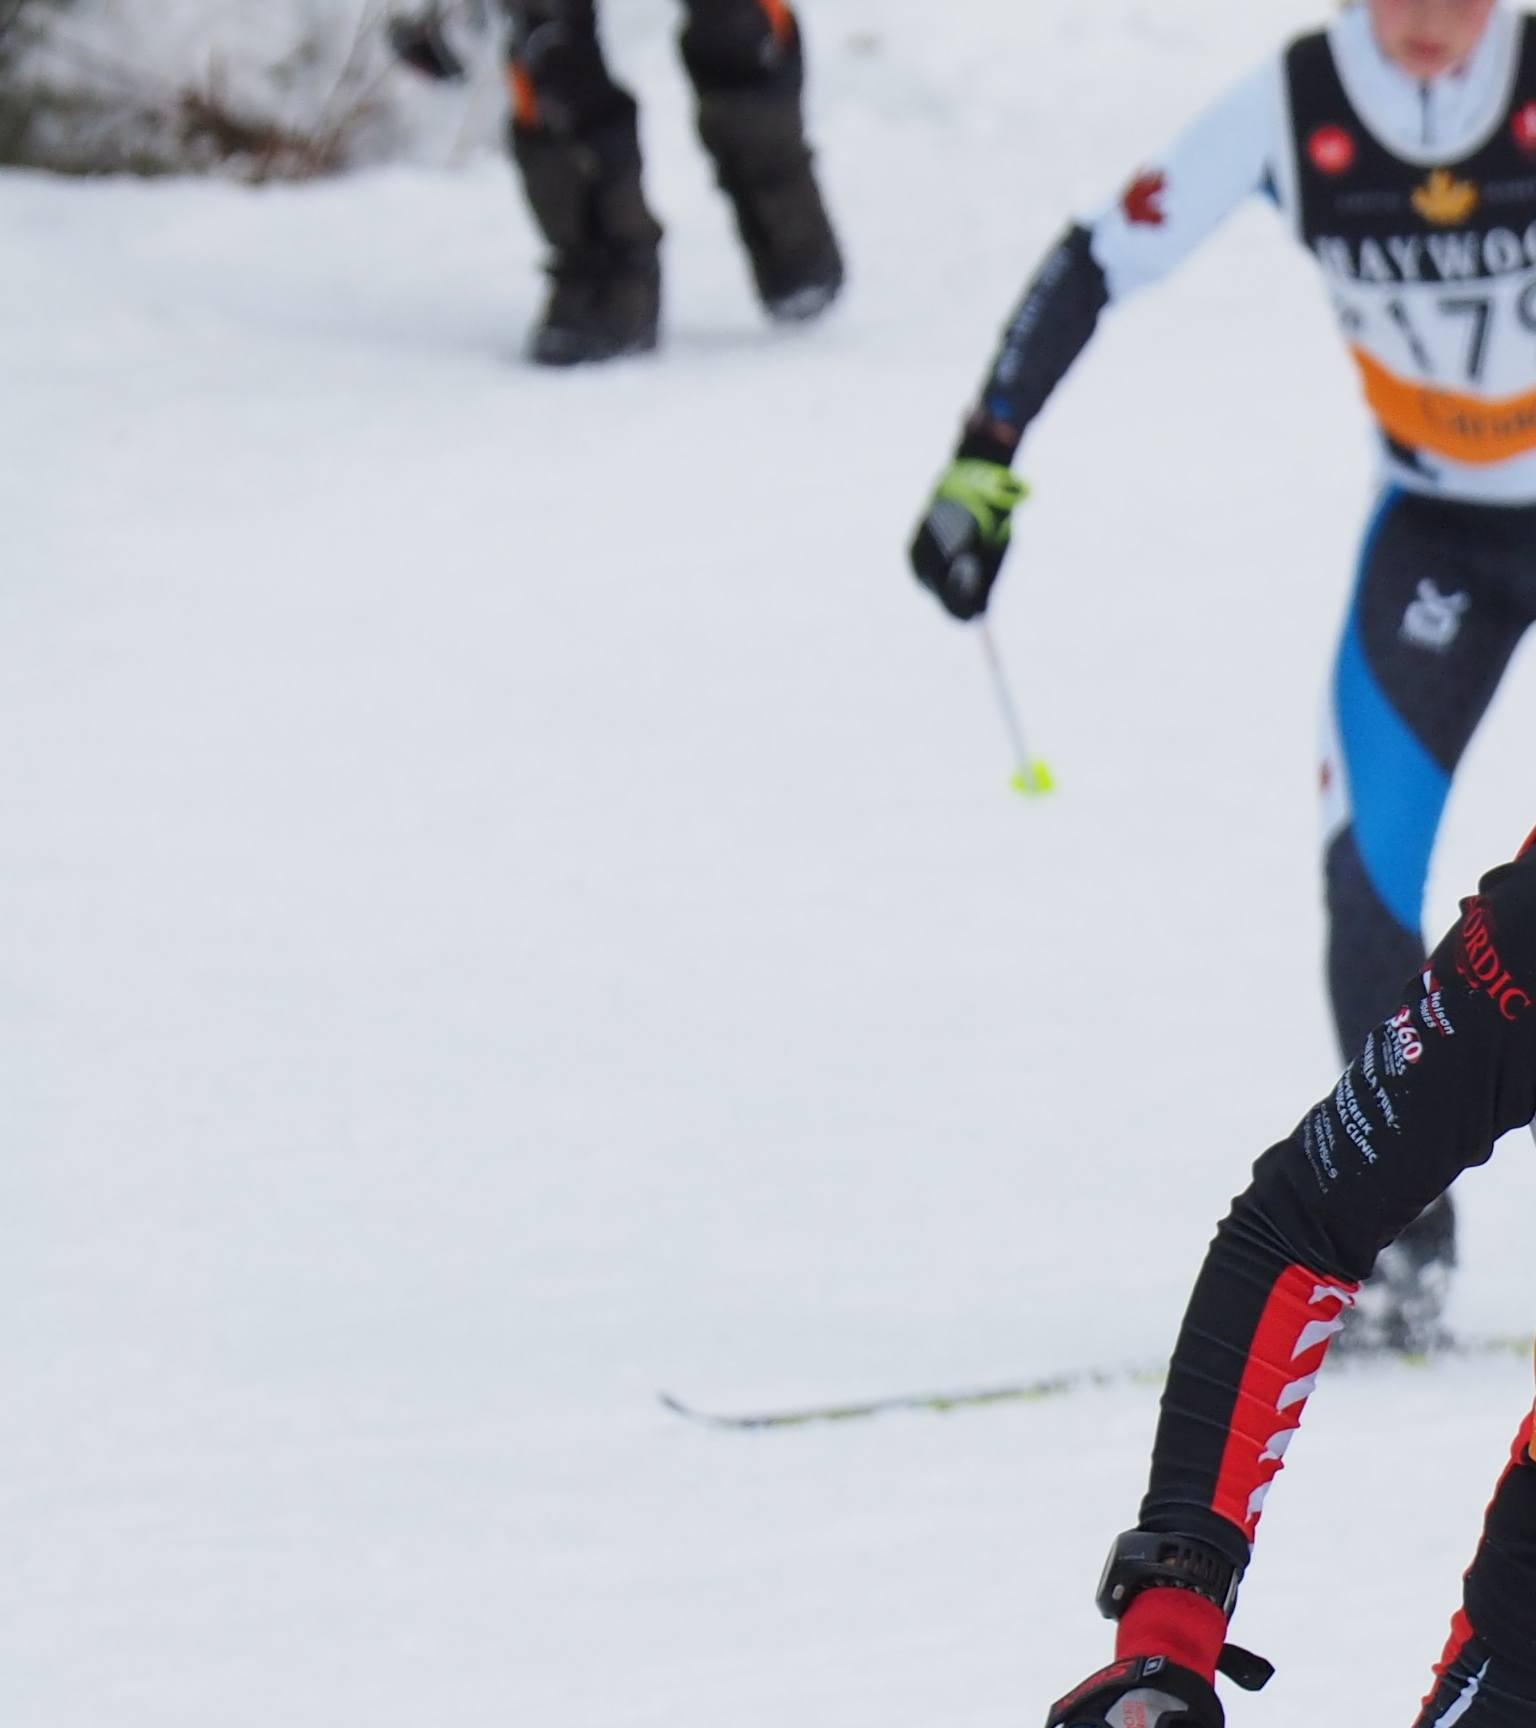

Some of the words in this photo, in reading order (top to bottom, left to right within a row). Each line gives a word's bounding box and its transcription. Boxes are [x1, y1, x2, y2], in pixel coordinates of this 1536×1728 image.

[1463, 897, 1534, 1021] ORDIC
[1391, 1007, 1423, 1061] 360
[1346, 1098, 1374, 1136] CREEK
[1345, 1122, 1378, 1164] CLINIC
